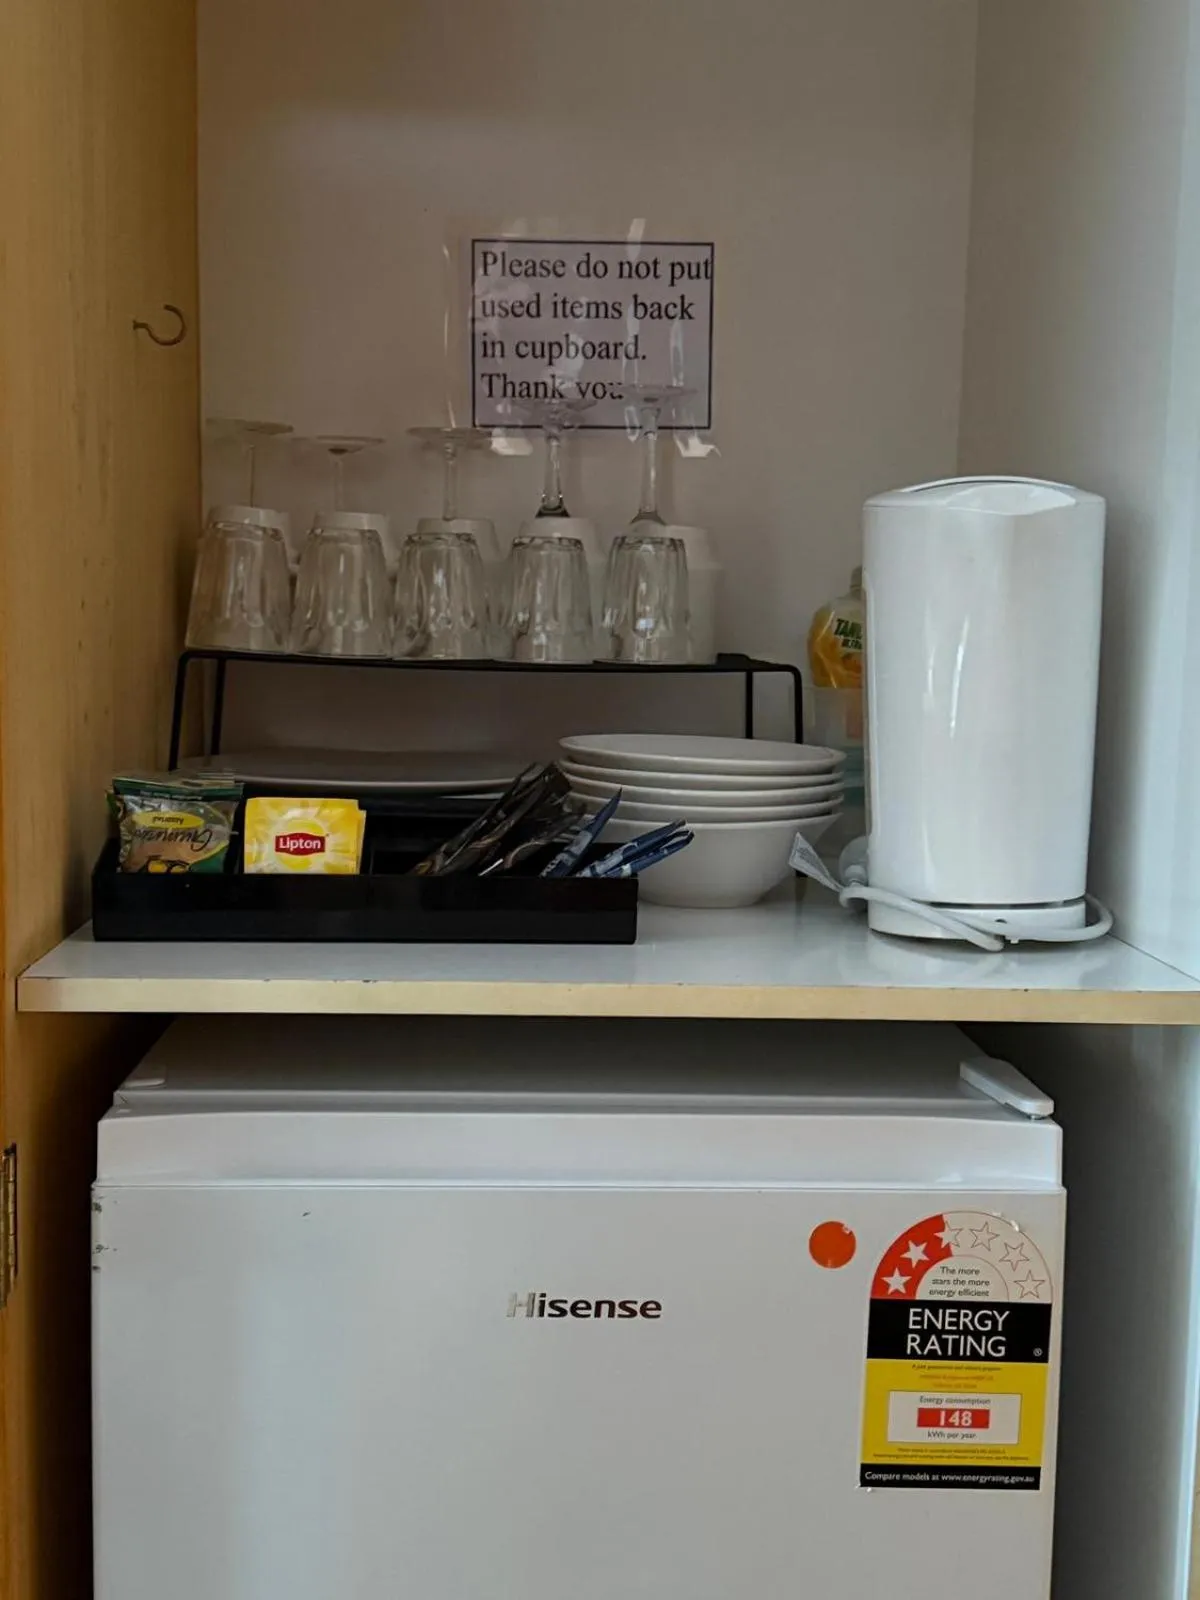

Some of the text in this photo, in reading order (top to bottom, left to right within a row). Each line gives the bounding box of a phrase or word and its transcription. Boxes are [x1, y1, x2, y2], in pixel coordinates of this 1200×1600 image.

[481, 251, 711, 287] Please do not put
[481, 293, 695, 320] used items back
[481, 332, 647, 366] in cupboard.
[481, 373, 564, 399] Thank
[279, 836, 321, 852] Lipton
[940, 1265, 980, 1276] The more
[932, 1278, 990, 1287] stars the more
[929, 1288, 990, 1298] energy efficient
[506, 1292, 662, 1319] Hisense
[908, 1307, 1010, 1332] ENERGY
[906, 1333, 1007, 1357] RATING
[919, 1395, 991, 1406] Energy consumption
[939, 1410, 973, 1427] 148
[927, 1430, 946, 1438] kWh
[960, 1433, 977, 1441] year
[864, 1471, 1036, 1485] Compare models at www.energyrating.gov.au
